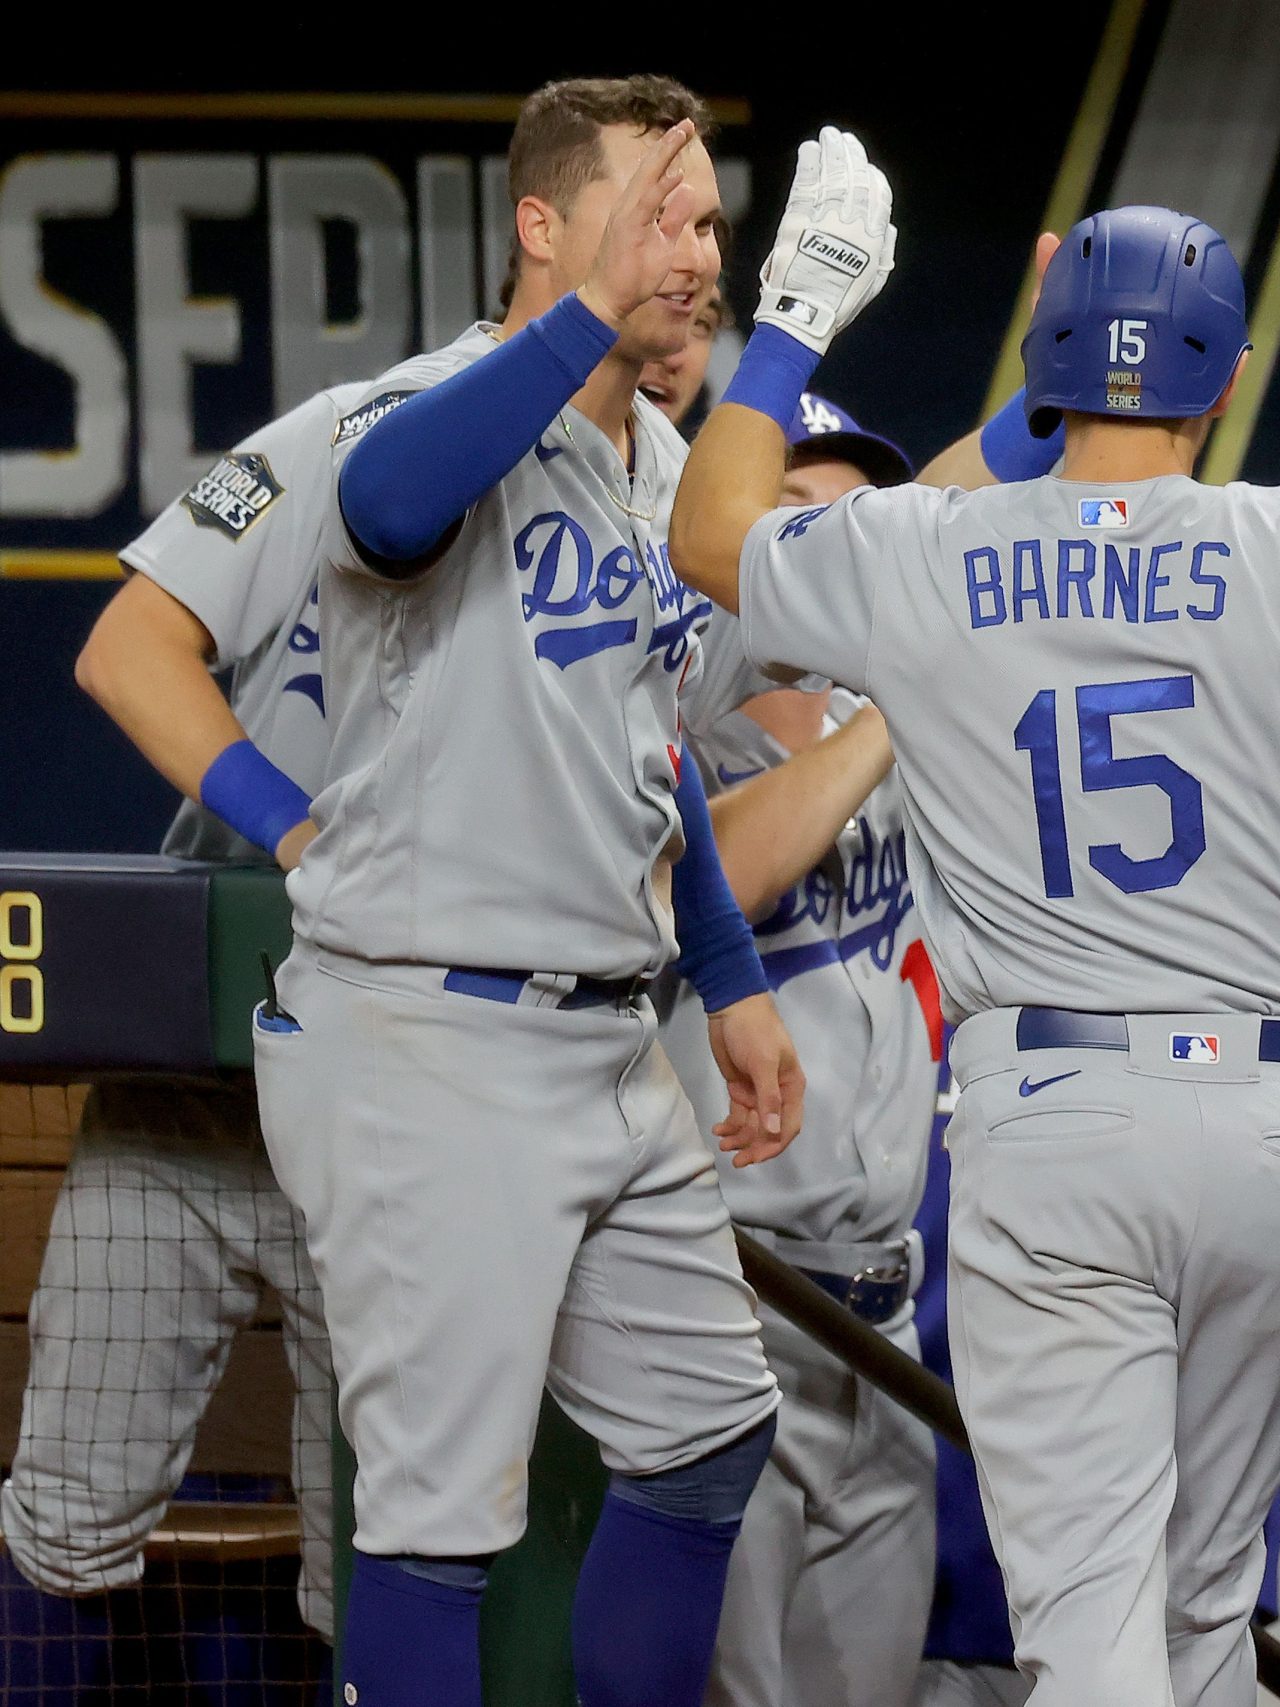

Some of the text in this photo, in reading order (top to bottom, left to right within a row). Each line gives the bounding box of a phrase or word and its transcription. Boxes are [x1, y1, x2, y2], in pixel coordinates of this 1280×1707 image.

[802, 233, 865, 272] Franklin
[0, 152, 750, 518] SERI
[1107, 319, 1148, 364] 15
[1106, 394, 1141, 409] SERIES
[1107, 371, 1142, 385] WORLD
[800, 392, 842, 434] LA
[187, 478, 256, 531] SERIES
[208, 457, 272, 516] WORLD
[964, 538, 1231, 629] BARNES
[1013, 675, 1206, 898] 15
